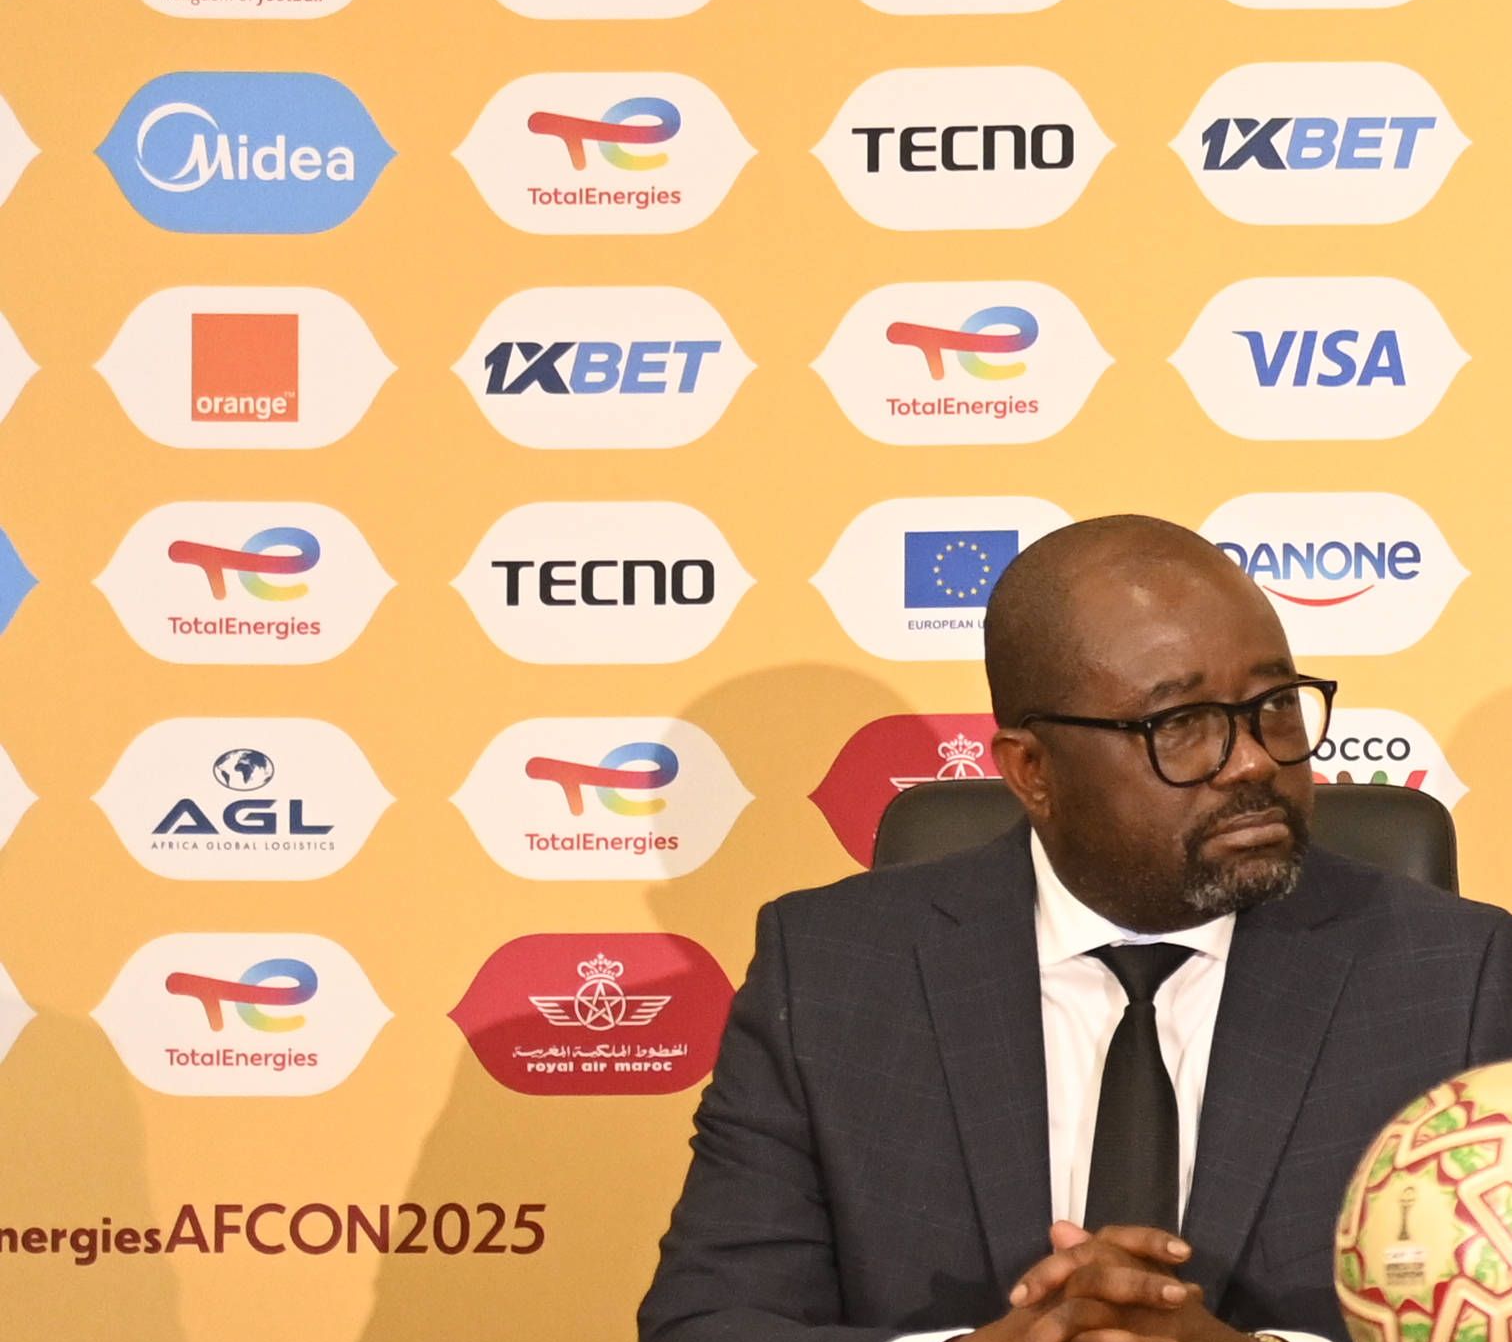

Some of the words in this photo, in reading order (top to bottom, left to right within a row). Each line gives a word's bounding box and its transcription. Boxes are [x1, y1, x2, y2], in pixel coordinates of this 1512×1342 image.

[178, 131, 354, 182] Midea
[852, 124, 1074, 172] TECNO
[1202, 118, 1436, 170] 1XBET
[528, 186, 681, 209] TotalEnergies
[485, 341, 721, 394] 1XBET
[1233, 330, 1406, 387] VISA
[196, 393, 289, 418] orange
[886, 396, 1038, 419] TotalEnergies
[492, 560, 714, 606] TECNO
[908, 620, 973, 630] EUROPEAN
[152, 799, 333, 834] AGL
[151, 840, 199, 851] AFRICA
[205, 841, 257, 851] GLOBAL
[264, 841, 335, 852] LOGISTICS
[165, 1048, 317, 1071] TotalEnergies
[526, 1061, 574, 1074] royal
[581, 1061, 608, 1072] air
[614, 1061, 673, 1072] maroc
